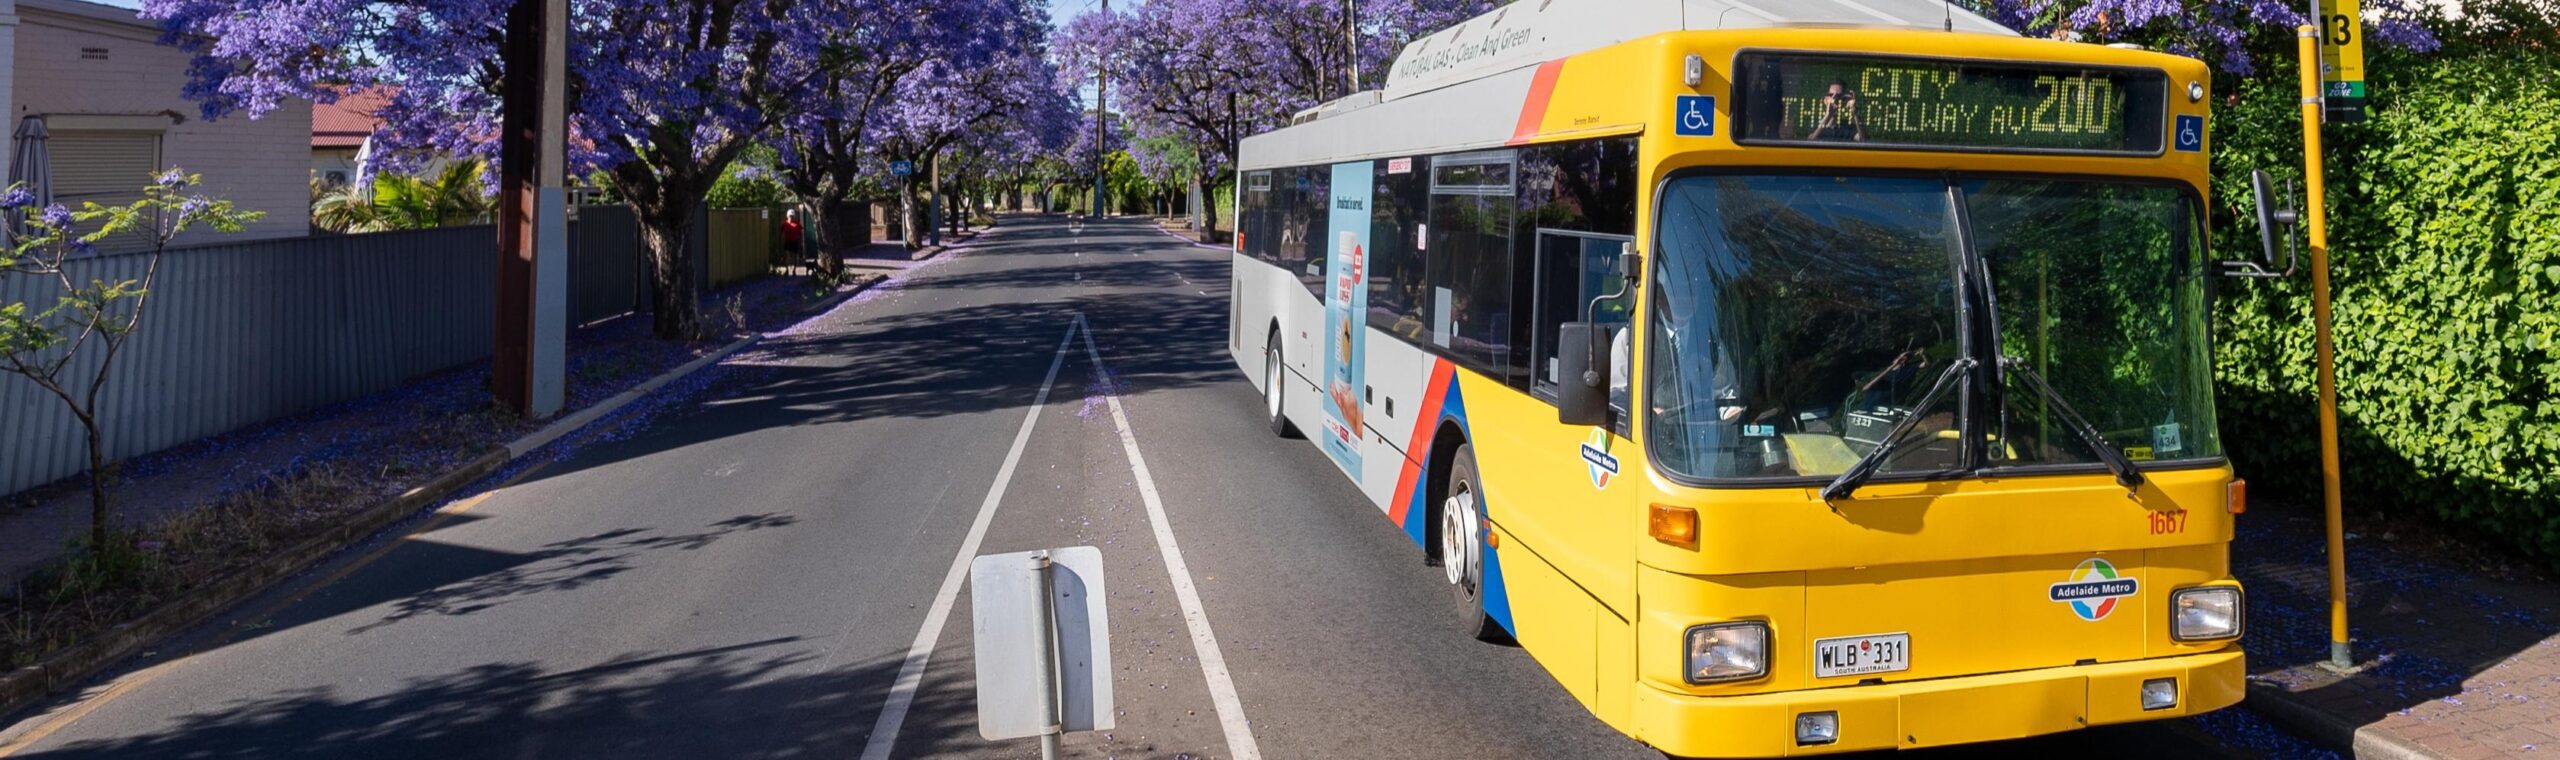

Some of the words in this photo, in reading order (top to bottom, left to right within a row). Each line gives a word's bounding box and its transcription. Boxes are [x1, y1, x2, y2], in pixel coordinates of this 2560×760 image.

[2320, 14, 2351, 46] 13
[1399, 54, 1431, 78] NATURAL
[1433, 48, 1451, 70] GAS
[1456, 43, 1478, 63] Clean
[1480, 34, 1501, 56] And
[1501, 27, 1531, 50] Green
[1861, 67, 1956, 99] CITY
[2328, 88, 2352, 97] ZONE
[2334, 81, 2347, 90] GO
[1866, 101, 1978, 133] GALWAY
[1990, 105, 2026, 135] AV
[2031, 75, 2112, 134] 200
[1583, 447, 1602, 464] Adelaide
[1602, 456, 1616, 470] Metro
[2147, 509, 2188, 535] 1667
[2057, 585, 2099, 598] Adelaide
[2101, 583, 2130, 593] Metro
[1821, 644, 1857, 669] WLB
[1873, 640, 1902, 664] 331
[1857, 665, 1891, 673] AUSTRALIA
